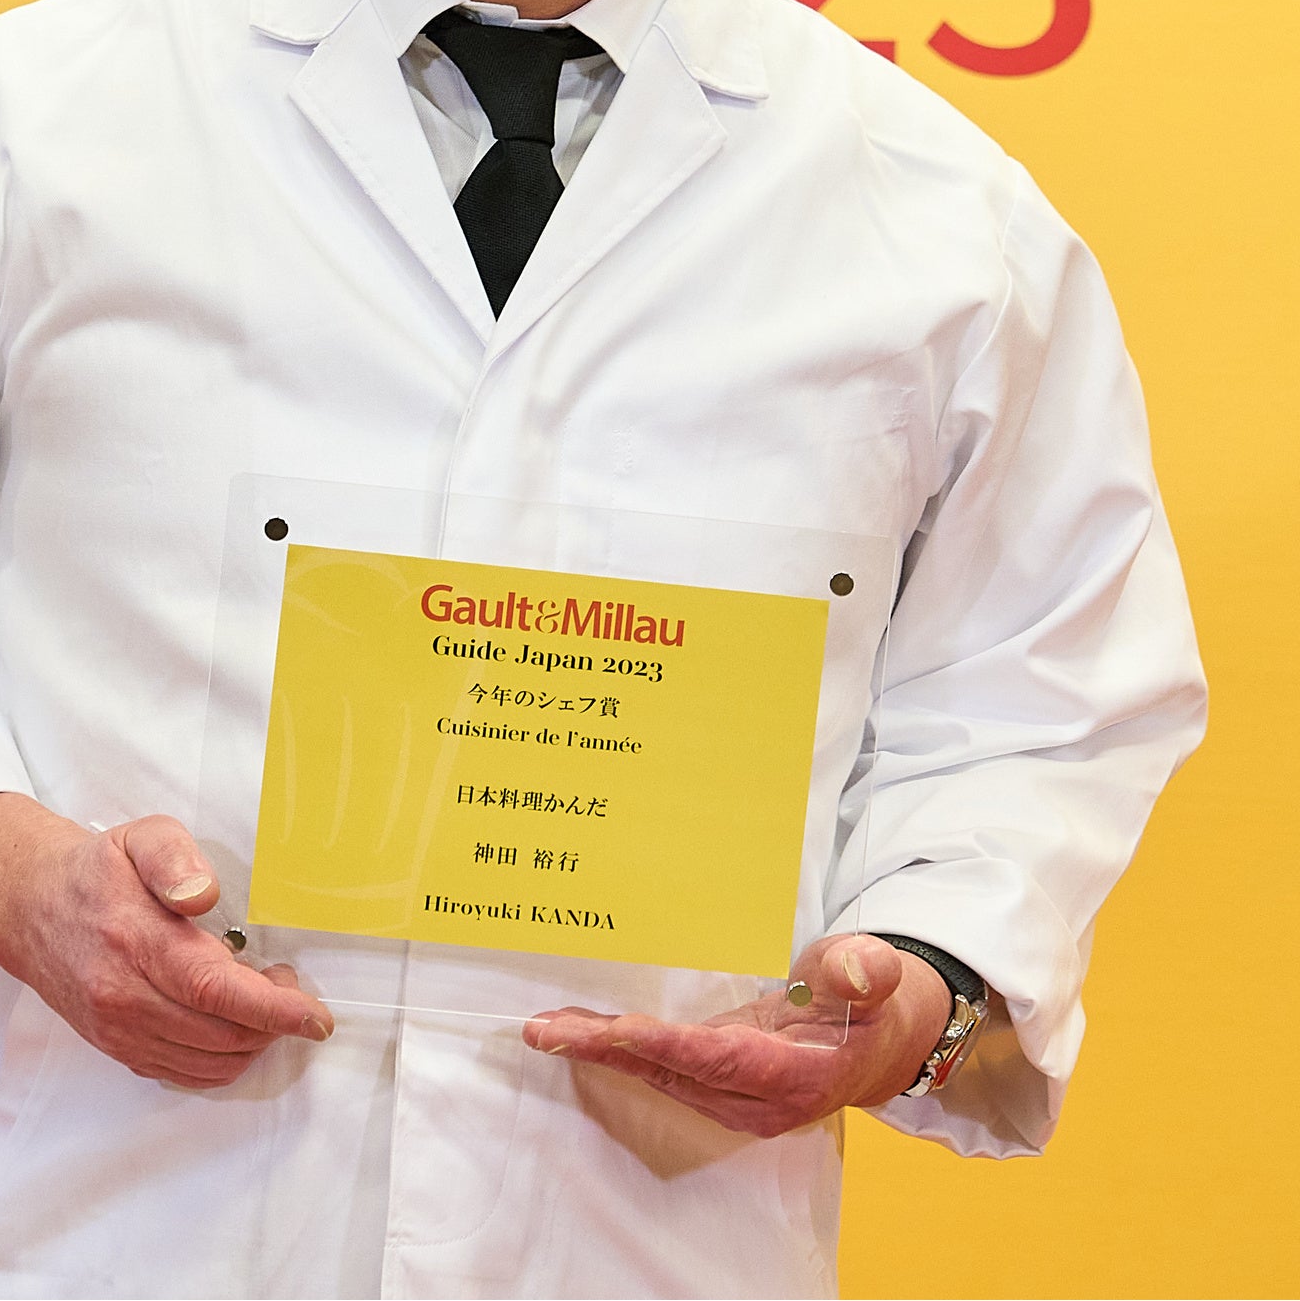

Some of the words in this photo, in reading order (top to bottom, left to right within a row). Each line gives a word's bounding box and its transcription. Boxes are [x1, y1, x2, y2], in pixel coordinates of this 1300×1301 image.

[432, 635, 507, 662] Guide
[514, 644, 594, 673] Japan
[602, 656, 664, 683] 2023
[467, 683, 621, 719] 今年のシェフ賞
[436, 717, 531, 743] Cuisinier
[536, 728, 560, 746] de
[457, 783, 609, 818] 日本料理かんだ
[423, 894, 521, 921] Hiroyuki
[530, 905, 616, 930] KANDA
